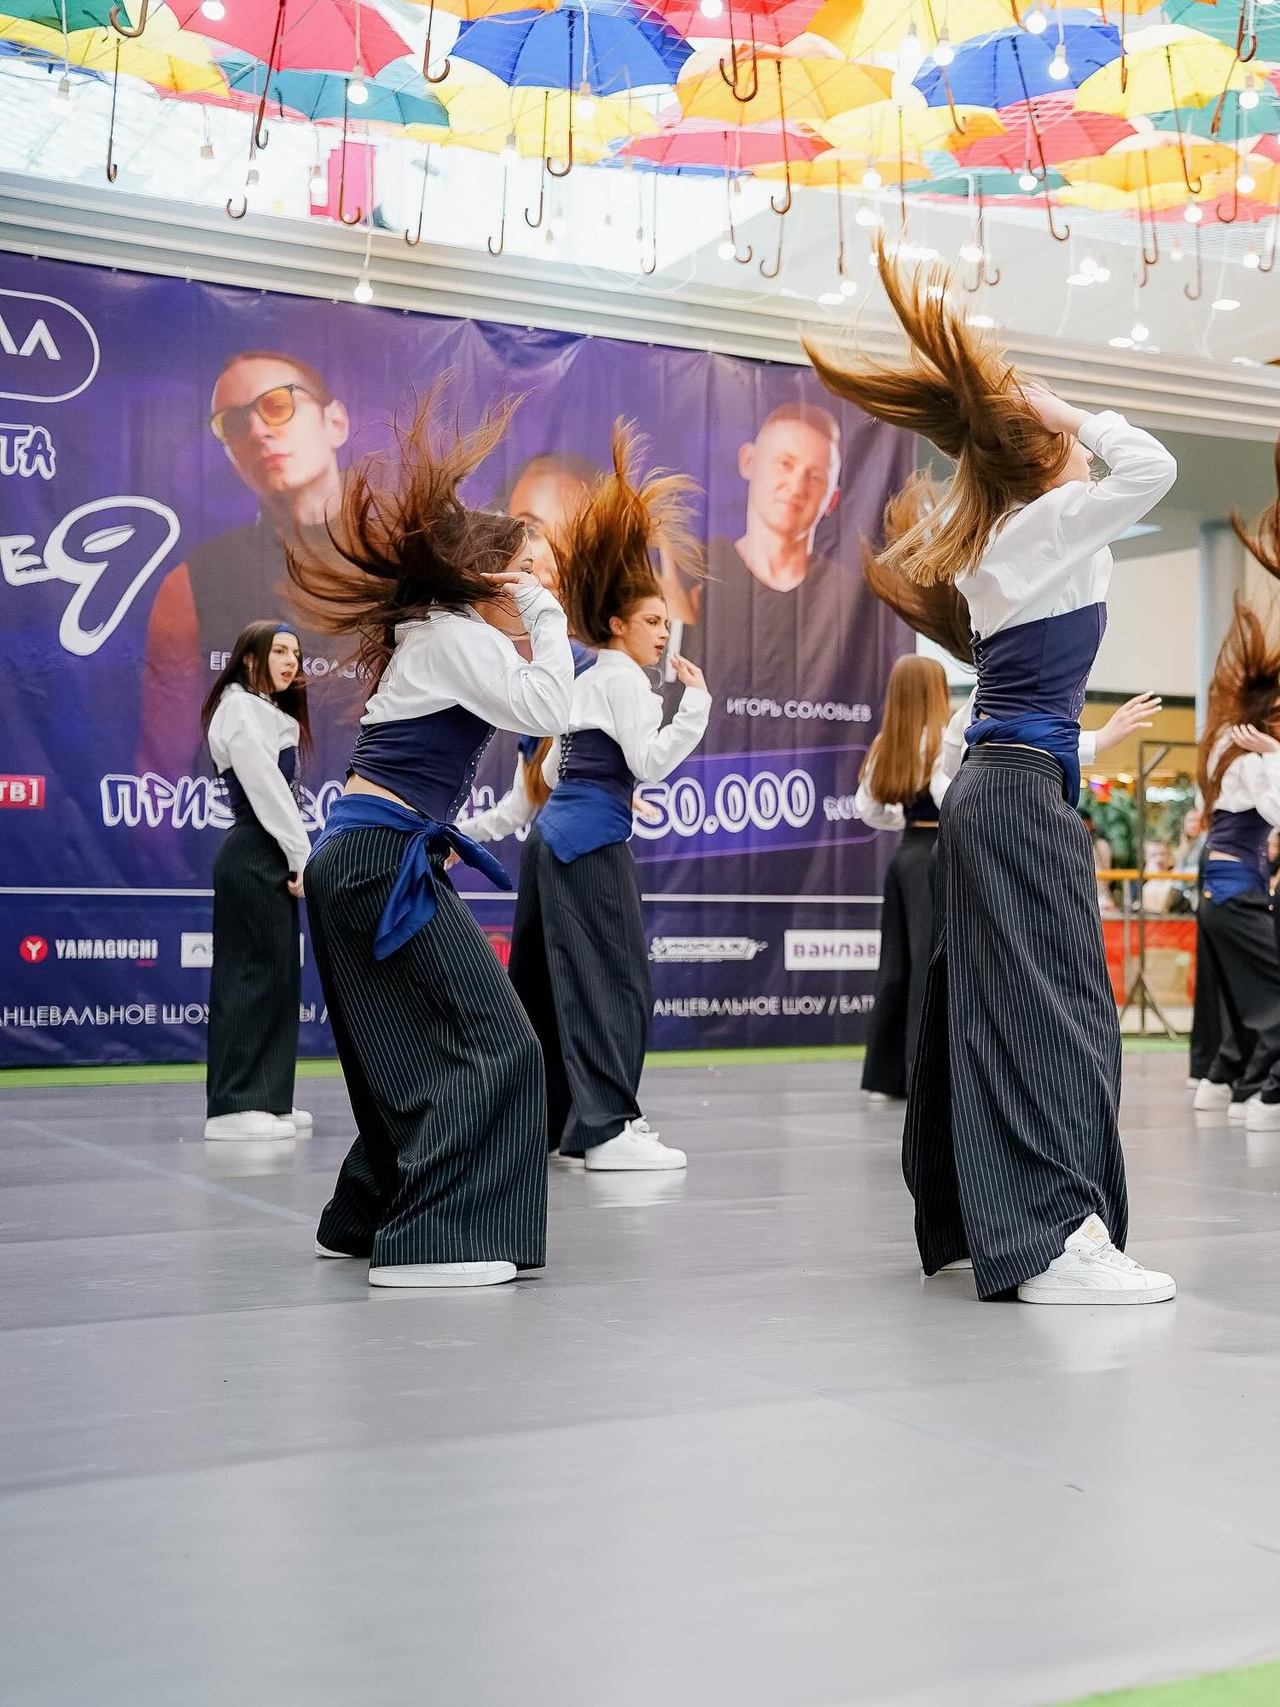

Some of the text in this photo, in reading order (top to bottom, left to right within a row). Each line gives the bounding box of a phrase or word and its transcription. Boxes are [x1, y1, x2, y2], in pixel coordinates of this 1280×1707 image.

[726, 697, 872, 722] ИГОРЬ СОЛОВЬЕВ
[55, 938, 158, 960] YAMAGUCHI
[781, 995, 825, 1016] ШОУ
